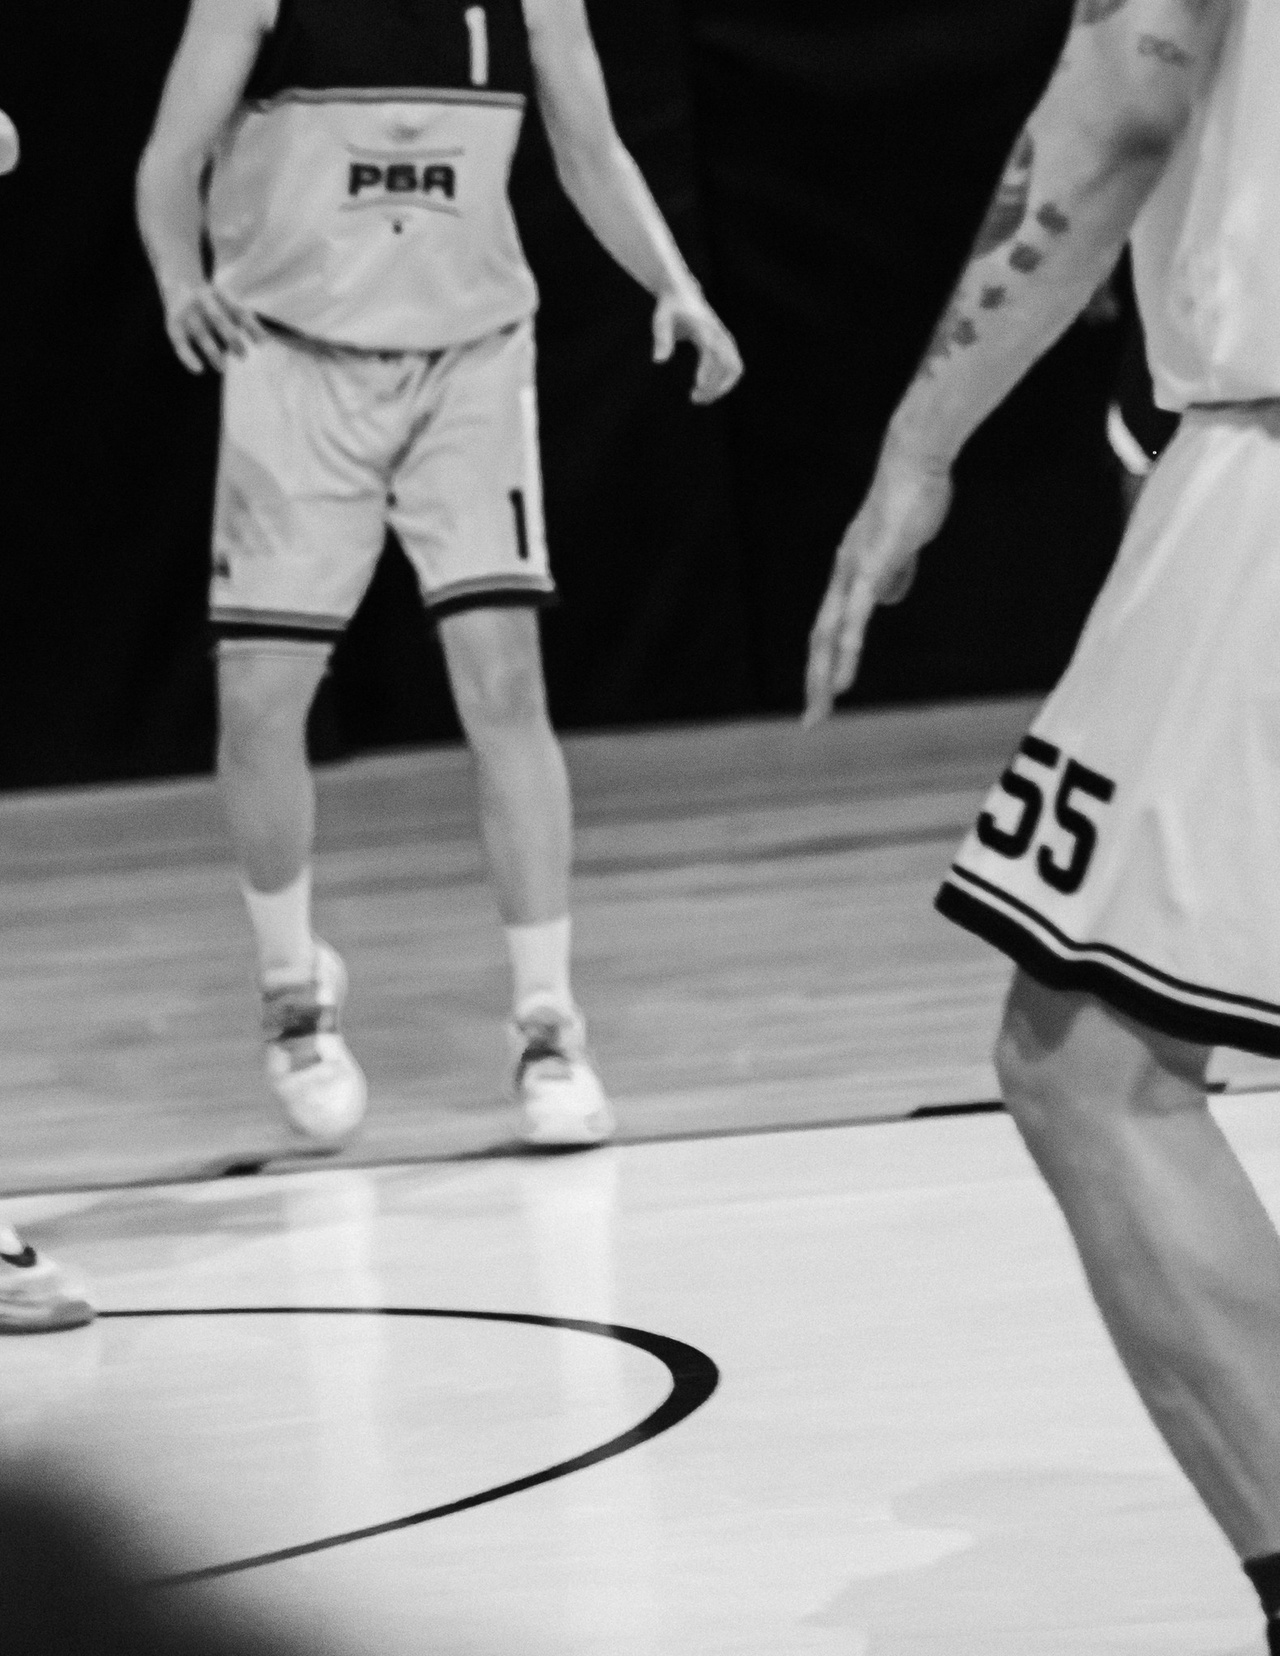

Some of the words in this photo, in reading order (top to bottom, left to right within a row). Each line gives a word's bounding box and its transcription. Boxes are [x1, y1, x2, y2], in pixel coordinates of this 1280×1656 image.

[465, 6, 487, 85] 1
[509, 489, 528, 560] 1
[976, 735, 1116, 895] 55
